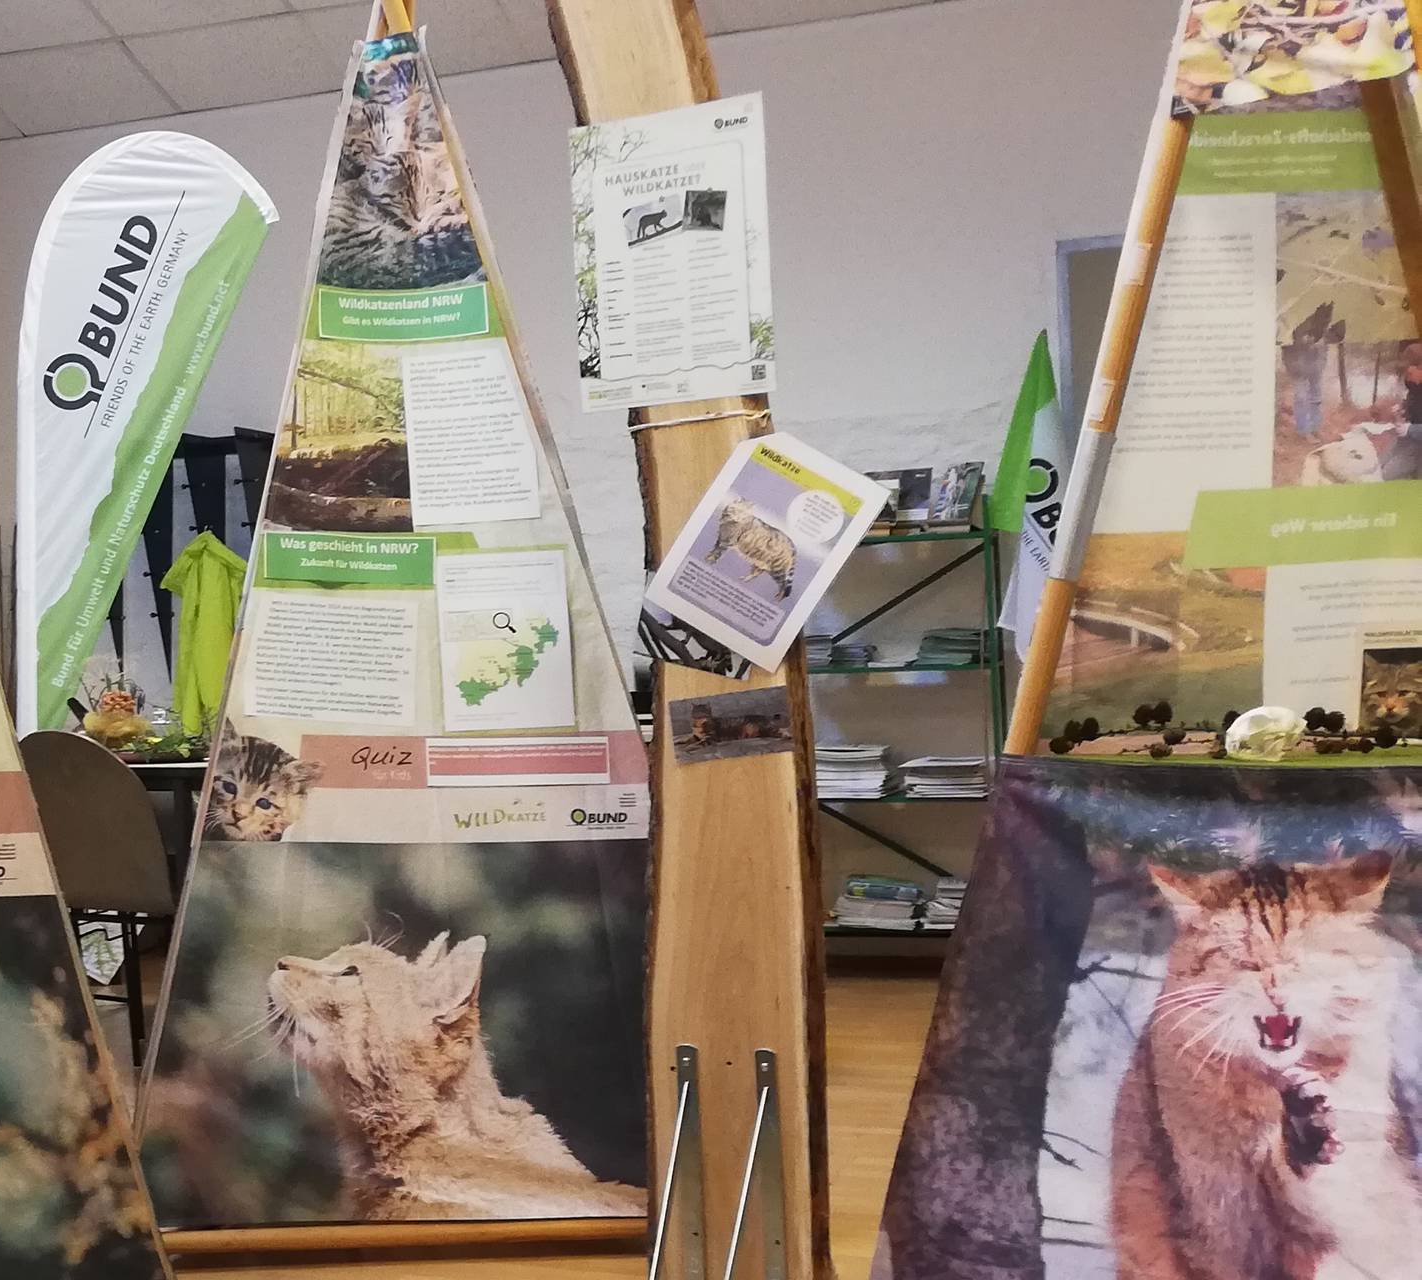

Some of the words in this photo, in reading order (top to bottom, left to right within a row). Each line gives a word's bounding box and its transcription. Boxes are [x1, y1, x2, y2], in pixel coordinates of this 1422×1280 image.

[605, 165, 679, 187] HAUSKATZE
[623, 174, 701, 197] WILDKATZE?
[156, 229, 190, 288] GERMANY
[78, 215, 158, 359] BUND
[140, 292, 164, 330] EARTH
[338, 297, 429, 311] Wildkatzenland
[432, 293, 464, 307] NRW
[186, 279, 230, 376] www.bund.net
[342, 315, 361, 326] Gibt
[362, 317, 371, 326] es
[372, 316, 421, 327] Wildkatzen
[422, 316, 431, 325] in
[433, 312, 461, 324] NRW?
[128, 334, 147, 357] THE
[122, 357, 136, 376] OF
[101, 377, 128, 428] FRIENDS
[143, 386, 187, 466] Deutschland
[760, 447, 801, 474] Wildkatze
[108, 467, 151, 546] Naturschutz
[280, 537, 306, 549] Was
[308, 540, 364, 553] geschieht
[366, 541, 377, 553] in
[380, 542, 419, 554] NRW?
[100, 547, 117, 576] und
[300, 557, 334, 568] Zukunft
[336, 559, 348, 568] für
[349, 560, 398, 571] Wildkatzen
[1030, 546, 1050, 572] EART
[75, 576, 106, 629] Umwelt
[66, 629, 85, 652] für
[51, 653, 75, 688] Bund
[351, 746, 413, 771] Quiz
[453, 809, 546, 829] WILDKATZE
[588, 812, 628, 824] BUND
